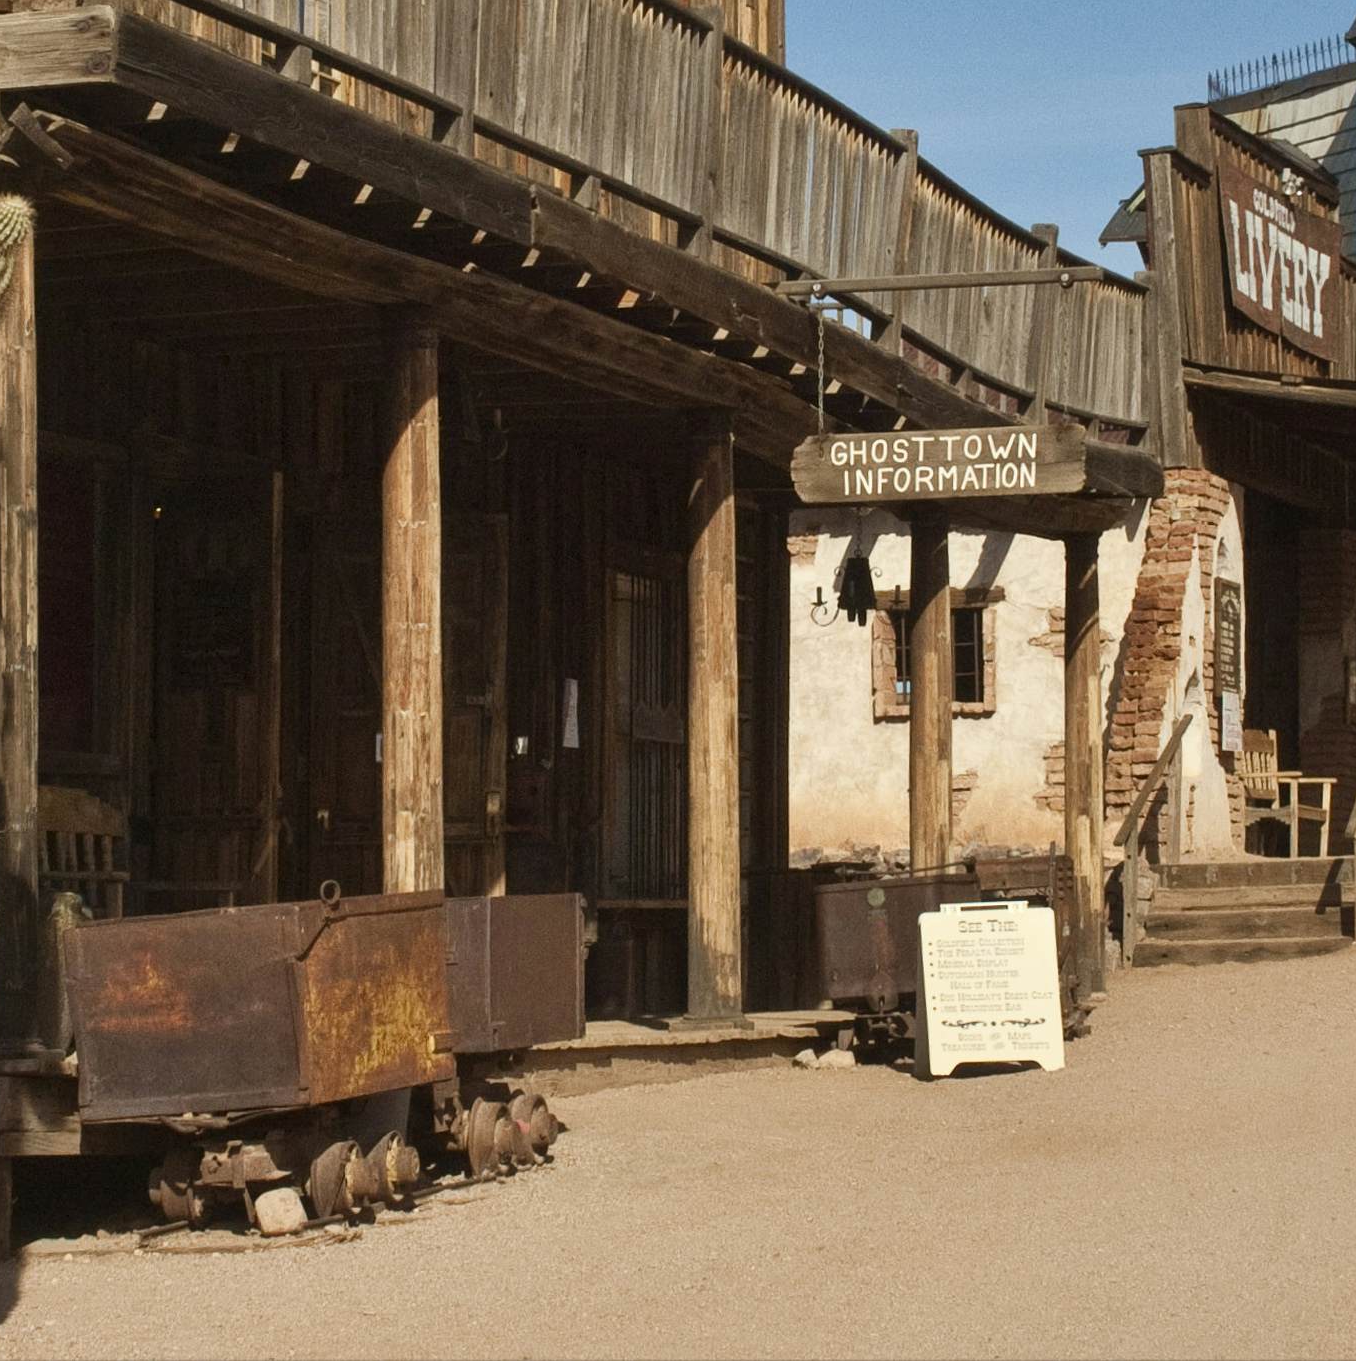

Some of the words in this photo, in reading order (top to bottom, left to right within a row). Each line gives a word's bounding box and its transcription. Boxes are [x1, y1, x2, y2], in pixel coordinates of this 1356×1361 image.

[1229, 199, 1331, 339] LIVERY
[830, 436, 935, 466] GHOST
[939, 433, 1037, 461] TOWN
[844, 462, 1036, 496] INFORMATION
[958, 920, 983, 933] SEE
